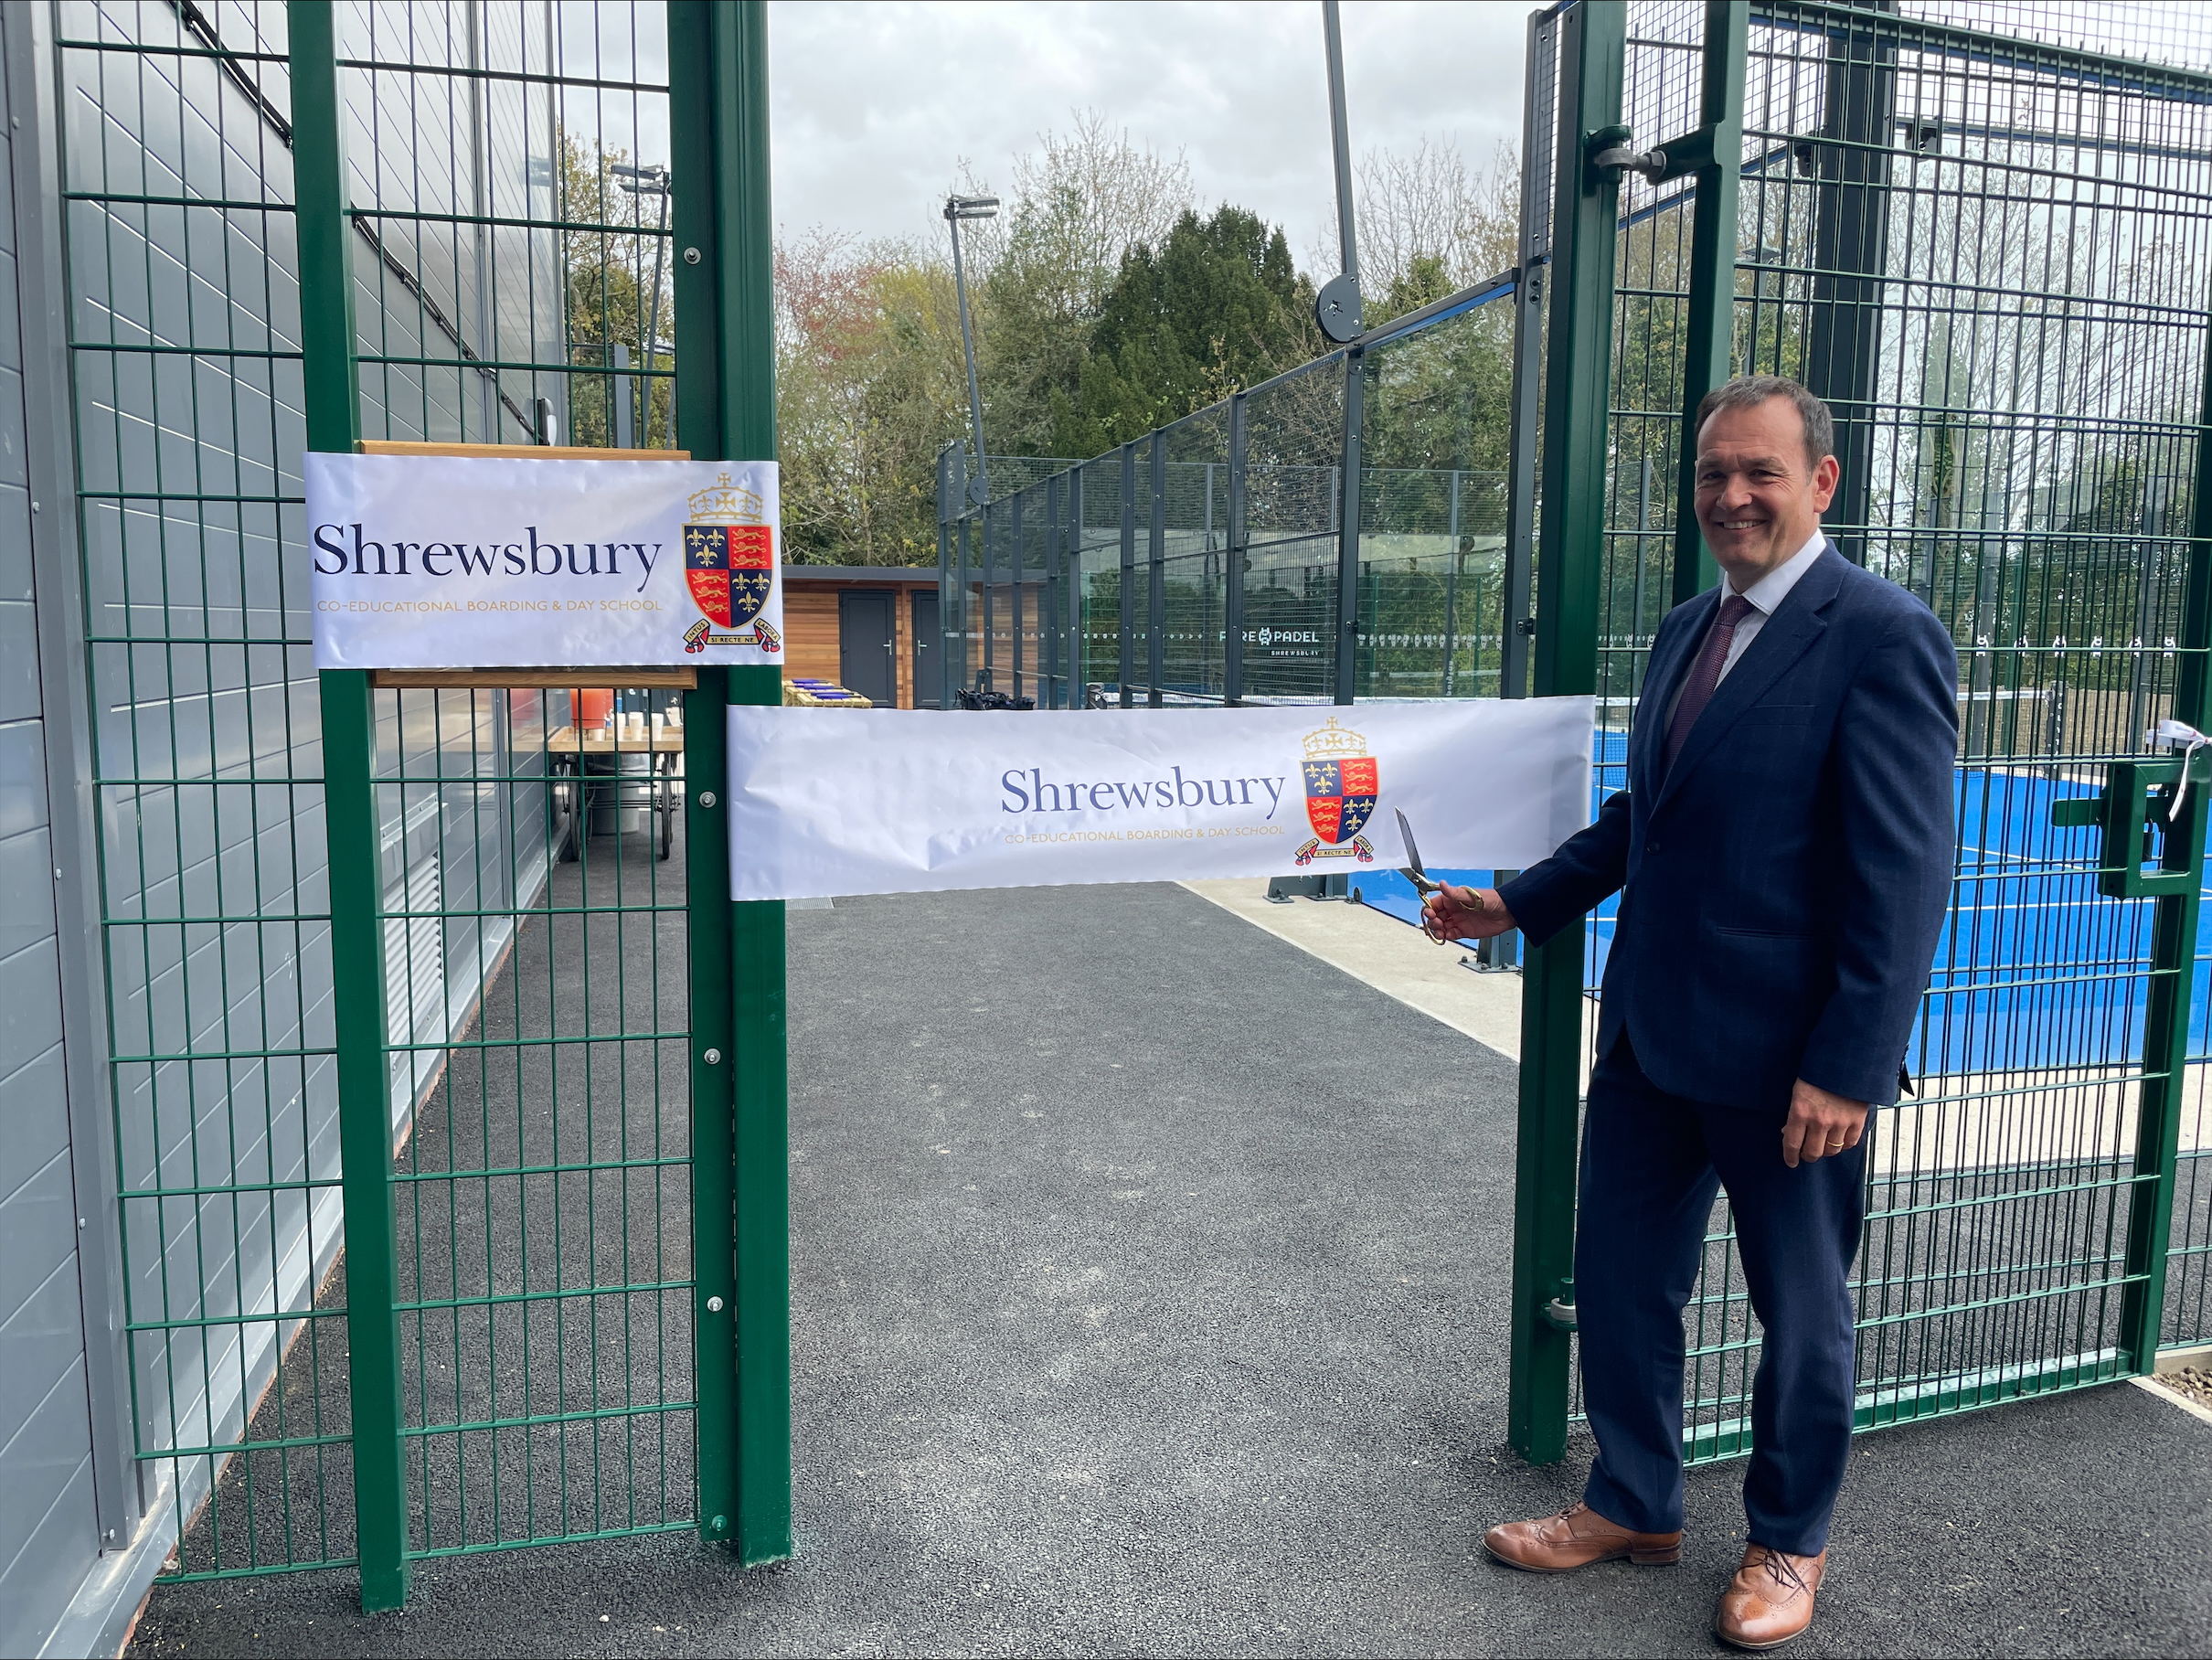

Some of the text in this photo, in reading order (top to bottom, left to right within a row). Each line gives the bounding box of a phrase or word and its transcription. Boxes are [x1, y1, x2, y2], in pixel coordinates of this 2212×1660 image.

[314, 523, 663, 593] Shrewsbury
[317, 600, 663, 612] CO-EDUCATIONAL BOARDING & DAY SCHOOL
[687, 622, 706, 640] INTUS
[757, 621, 778, 640] LABORA
[1274, 631, 1319, 642] PADEL
[1002, 765, 1286, 820] Shrewsbury
[1005, 825, 1285, 844] CO-EDUCATIONAL BOARDING & DAY SCHOOL
[1299, 841, 1315, 855] INTUS
